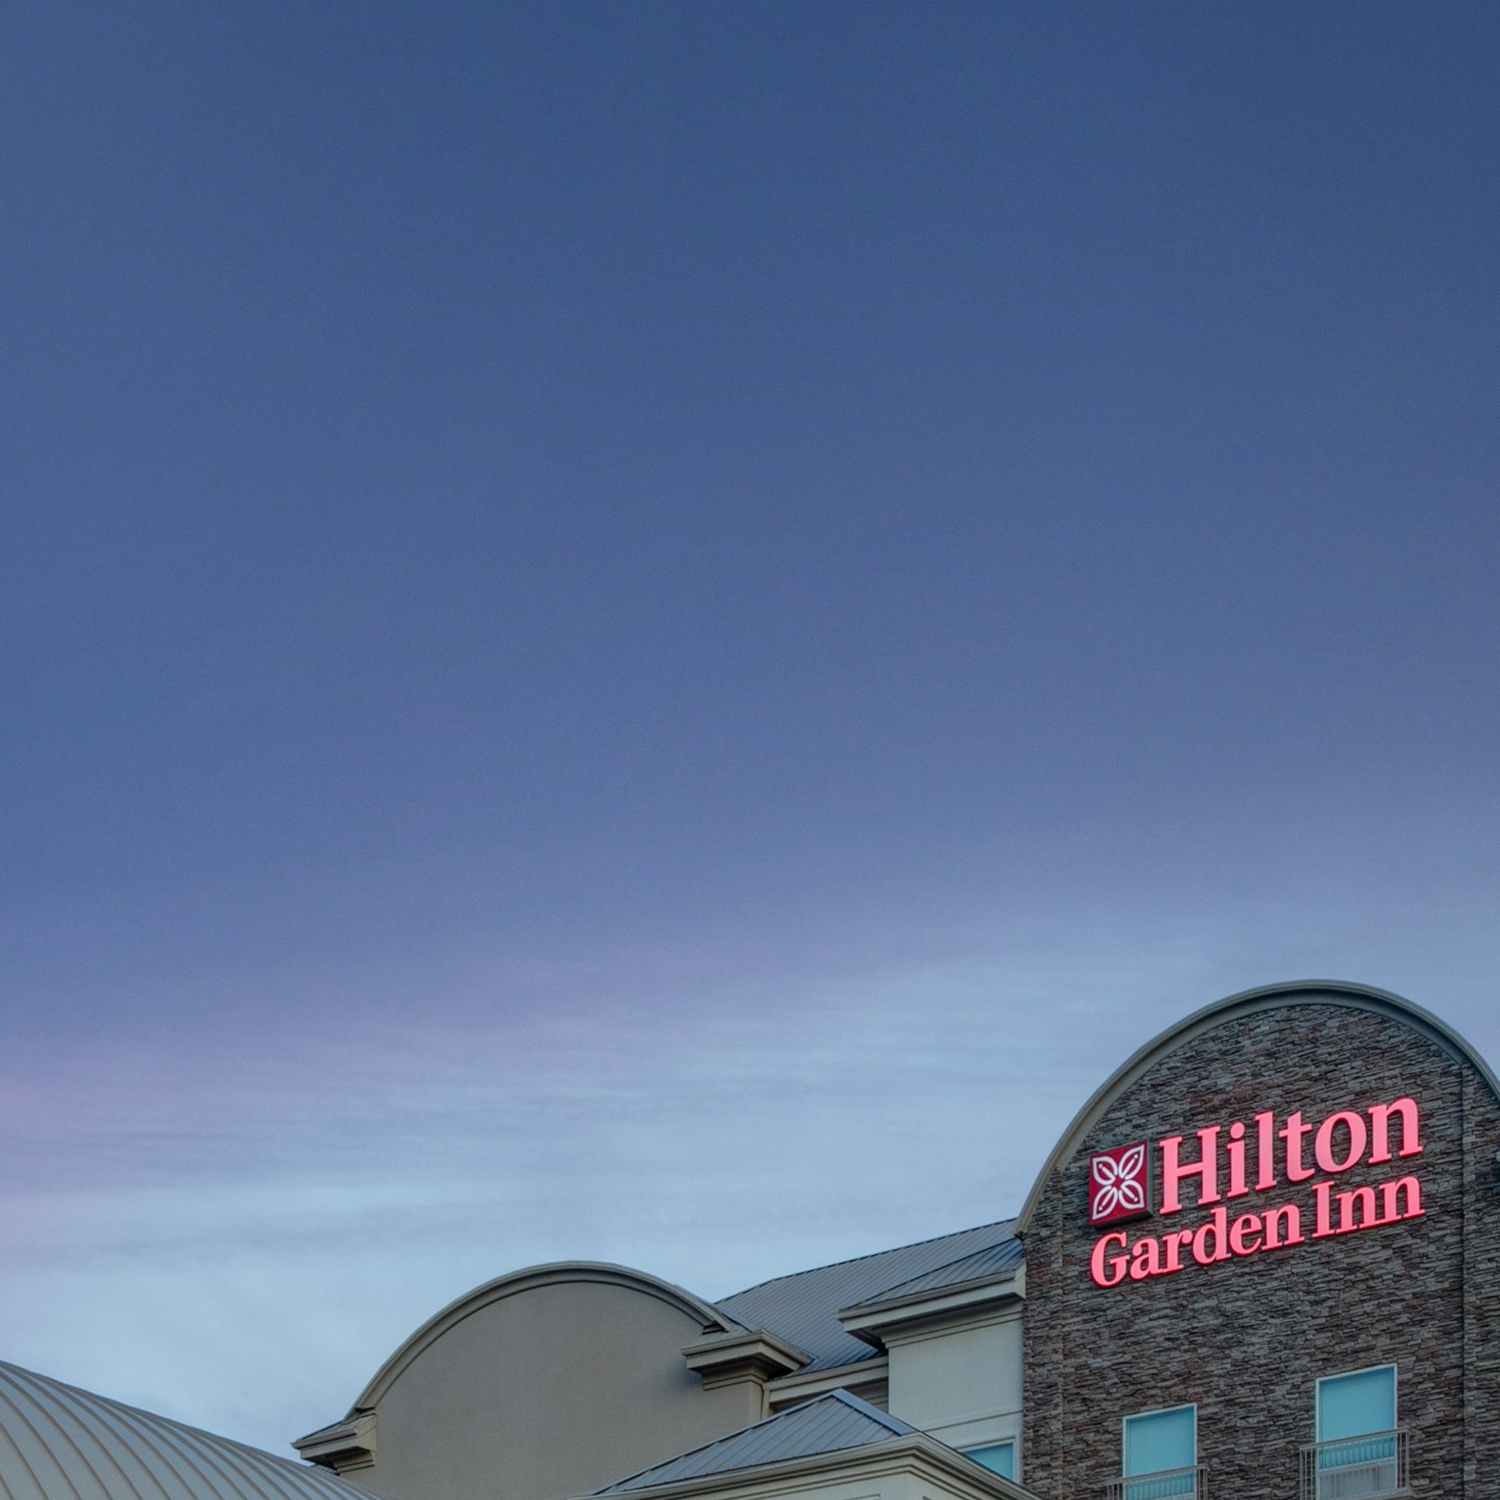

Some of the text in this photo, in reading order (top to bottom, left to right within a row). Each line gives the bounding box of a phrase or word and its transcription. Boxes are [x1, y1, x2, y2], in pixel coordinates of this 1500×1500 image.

[1159, 1097, 1424, 1216] Hilton
[1090, 1175, 1426, 1288] Garden Inn
